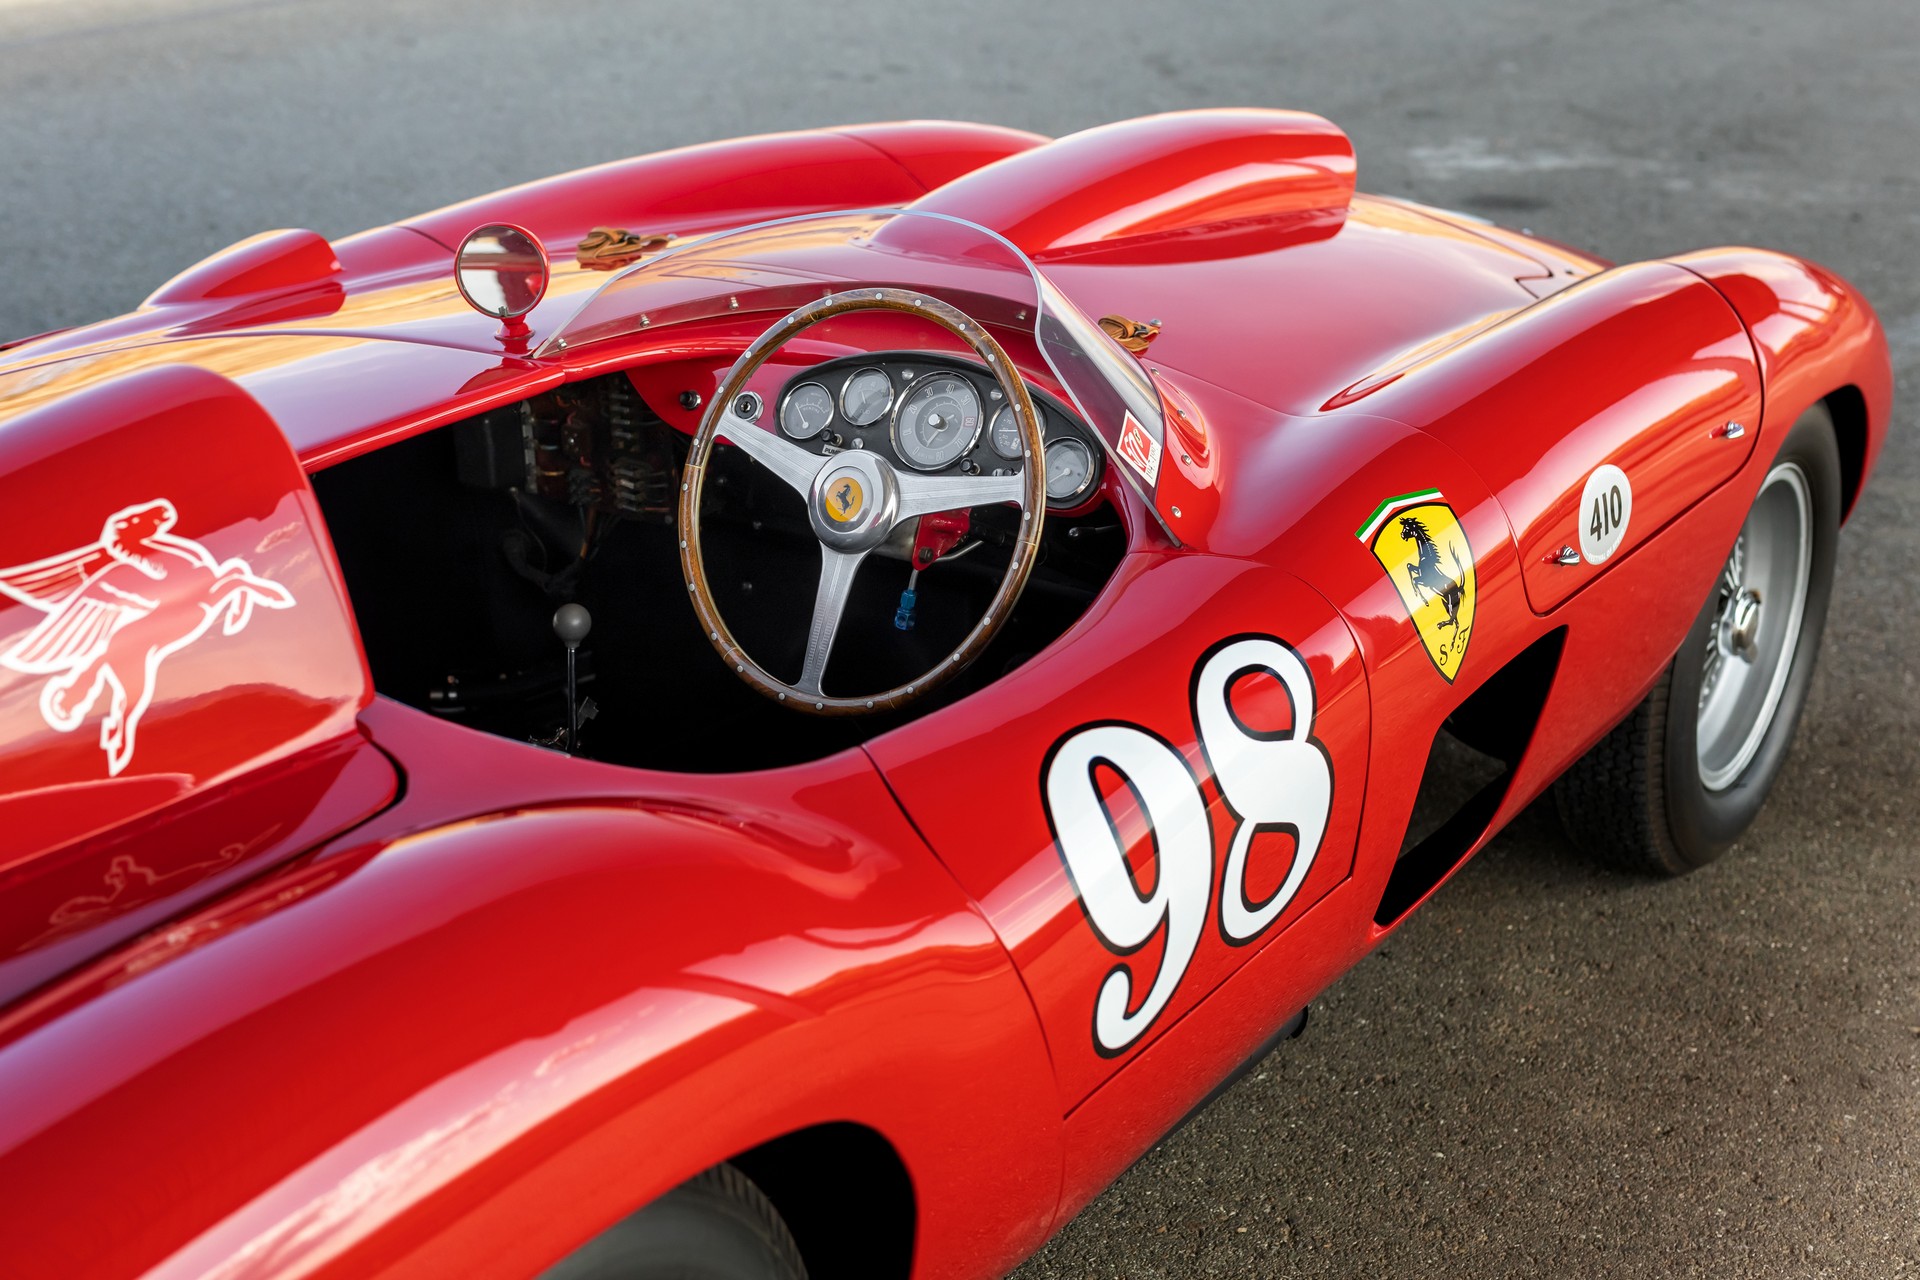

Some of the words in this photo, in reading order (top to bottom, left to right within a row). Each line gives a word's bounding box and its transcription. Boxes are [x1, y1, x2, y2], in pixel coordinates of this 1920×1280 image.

[925, 386, 933, 398] 30
[945, 383, 955, 394] 40
[1590, 485, 1622, 541] 410
[1439, 644, 1448, 666] S
[1039, 632, 1335, 1059] 98
